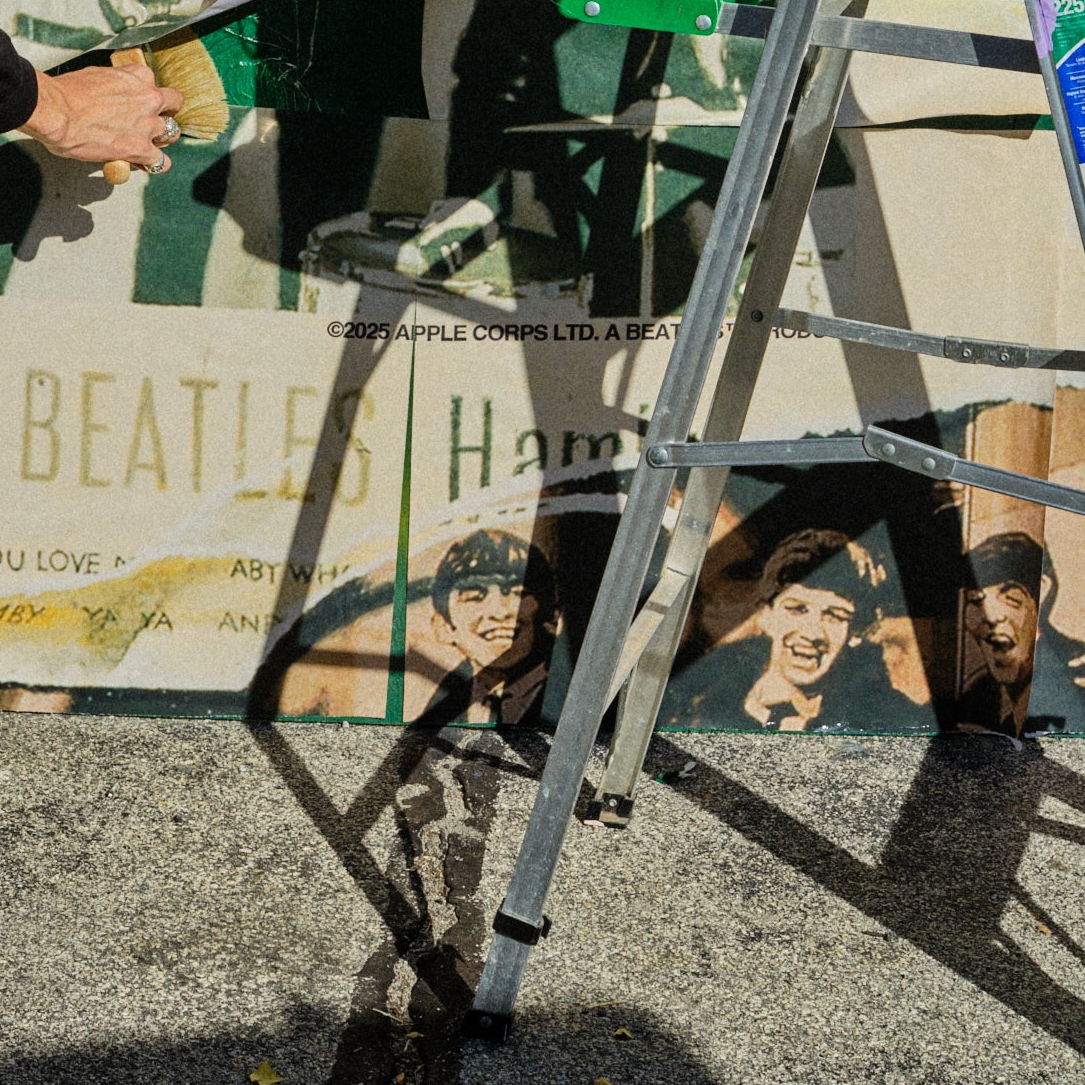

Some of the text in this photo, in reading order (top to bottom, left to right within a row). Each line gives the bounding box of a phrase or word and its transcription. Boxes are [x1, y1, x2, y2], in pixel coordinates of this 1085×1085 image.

[327, 321, 391, 340] ©2025
[394, 324, 467, 342] APPLE
[473, 324, 549, 341] CORPS
[554, 324, 600, 341] LTD.
[604, 324, 621, 341] A
[21, 367, 375, 508] BEATLES
[37, 550, 101, 575] LOVE
